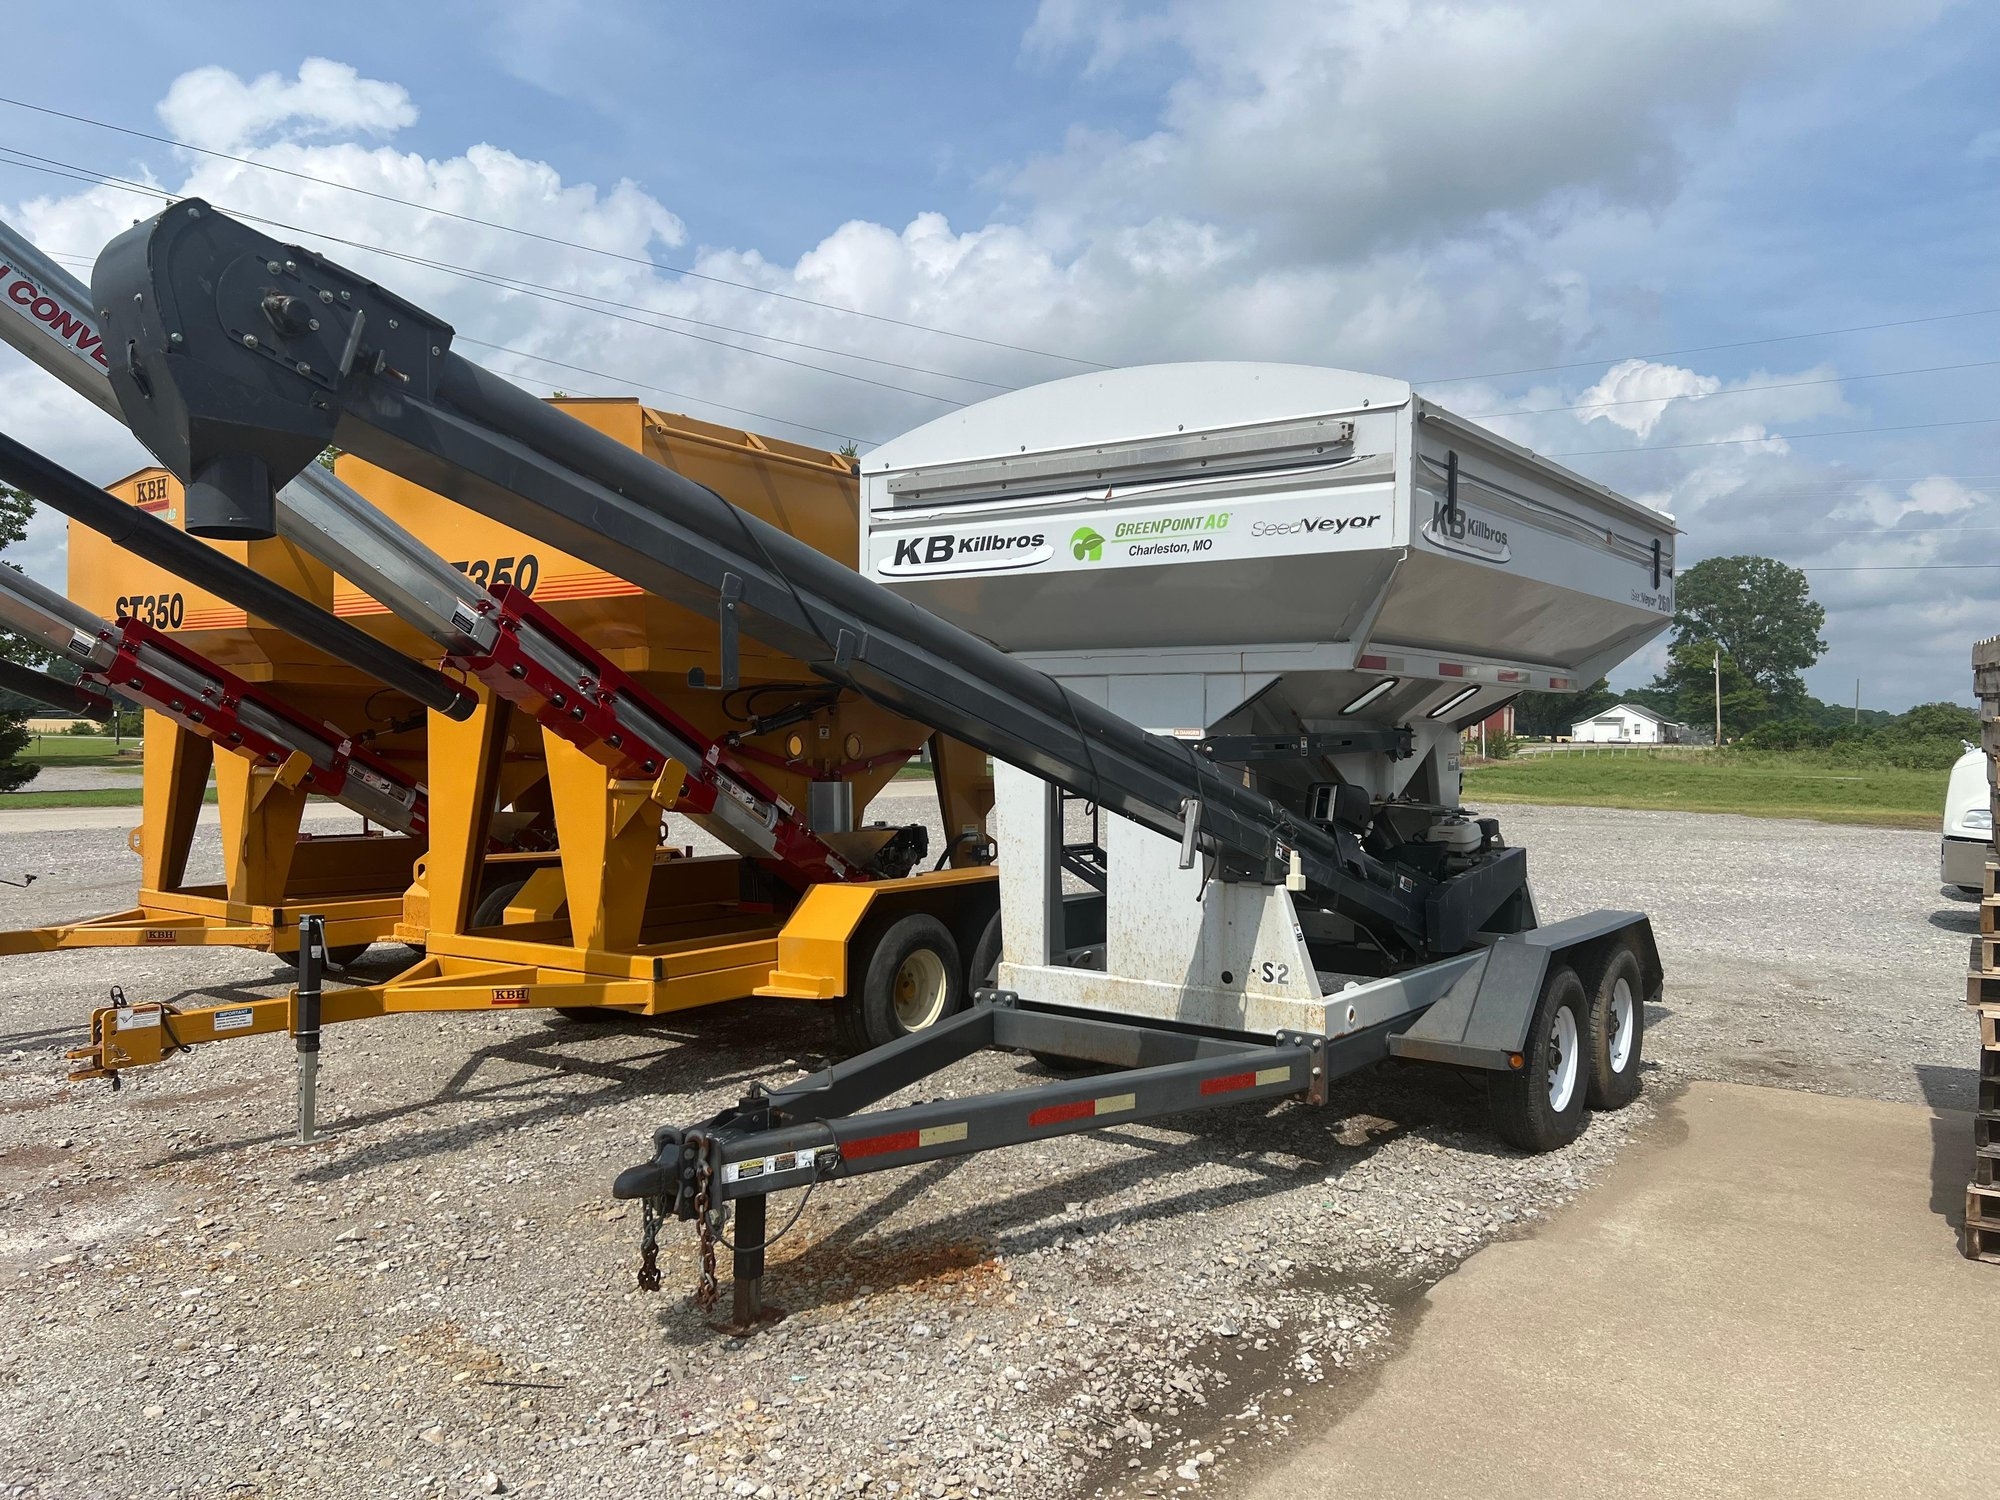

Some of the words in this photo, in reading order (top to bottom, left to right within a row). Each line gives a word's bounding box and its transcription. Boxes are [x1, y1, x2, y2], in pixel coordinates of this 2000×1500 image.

[137, 478, 167, 503] KBH
[1203, 512, 1230, 530] AG
[1432, 500, 1467, 540] KB
[1467, 518, 1508, 546] Killbros
[893, 534, 955, 566] KB
[958, 533, 1045, 554] Killbros
[1128, 543, 1190, 557] Charleston,
[1192, 539, 1213, 551] MO
[115, 592, 184, 630] ST350
[149, 931, 173, 939] KBH
[1262, 962, 1289, 985] S2
[495, 989, 527, 999] KBH
